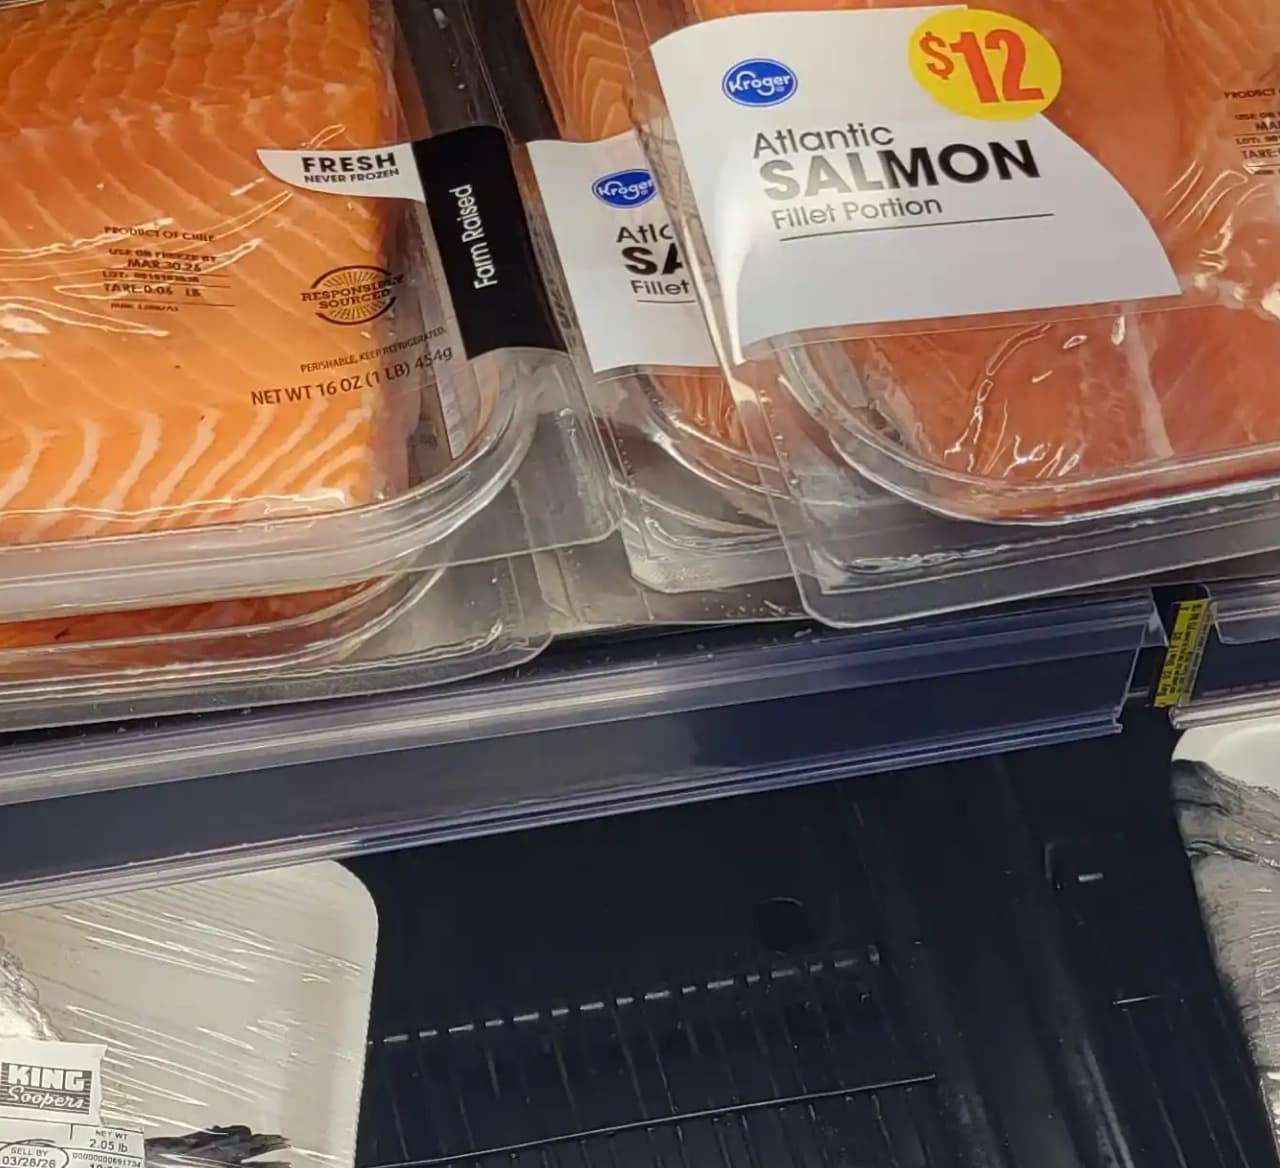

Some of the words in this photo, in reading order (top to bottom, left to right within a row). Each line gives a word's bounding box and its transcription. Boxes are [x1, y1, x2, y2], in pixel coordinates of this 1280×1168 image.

[920, 29, 1045, 104] $12
[729, 68, 792, 98] Kroger
[752, 123, 895, 159] Atlantic
[302, 152, 397, 173] FRESH
[304, 174, 346, 184] NEVER
[350, 168, 400, 182] FROZEN
[761, 139, 1040, 202] SALMON
[598, 180, 654, 200] Kroger
[449, 184, 485, 242] Raised
[771, 203, 836, 230] Fillet
[844, 194, 943, 222] Portion
[469, 243, 498, 289] Farm
[301, 274, 404, 302] RESPONSIBLY
[319, 289, 391, 310] SOURCED
[630, 279, 690, 295] Fillet
[251, 388, 282, 406] NET
[285, 384, 312, 402] WT
[317, 380, 336, 396] 16
[342, 376, 362, 391] OZ
[366, 371, 380, 387] (1
[386, 363, 410, 380] LB)
[414, 347, 453, 370] 454g
[8, 1063, 85, 1091] KING
[8, 1086, 84, 1109] Soopers
[10, 1146, 34, 1155] SELL
[89, 1139, 115, 1150] 2.05
[118, 1141, 128, 1152] lb
[2, 1156, 56, 1168] 03/28/26
